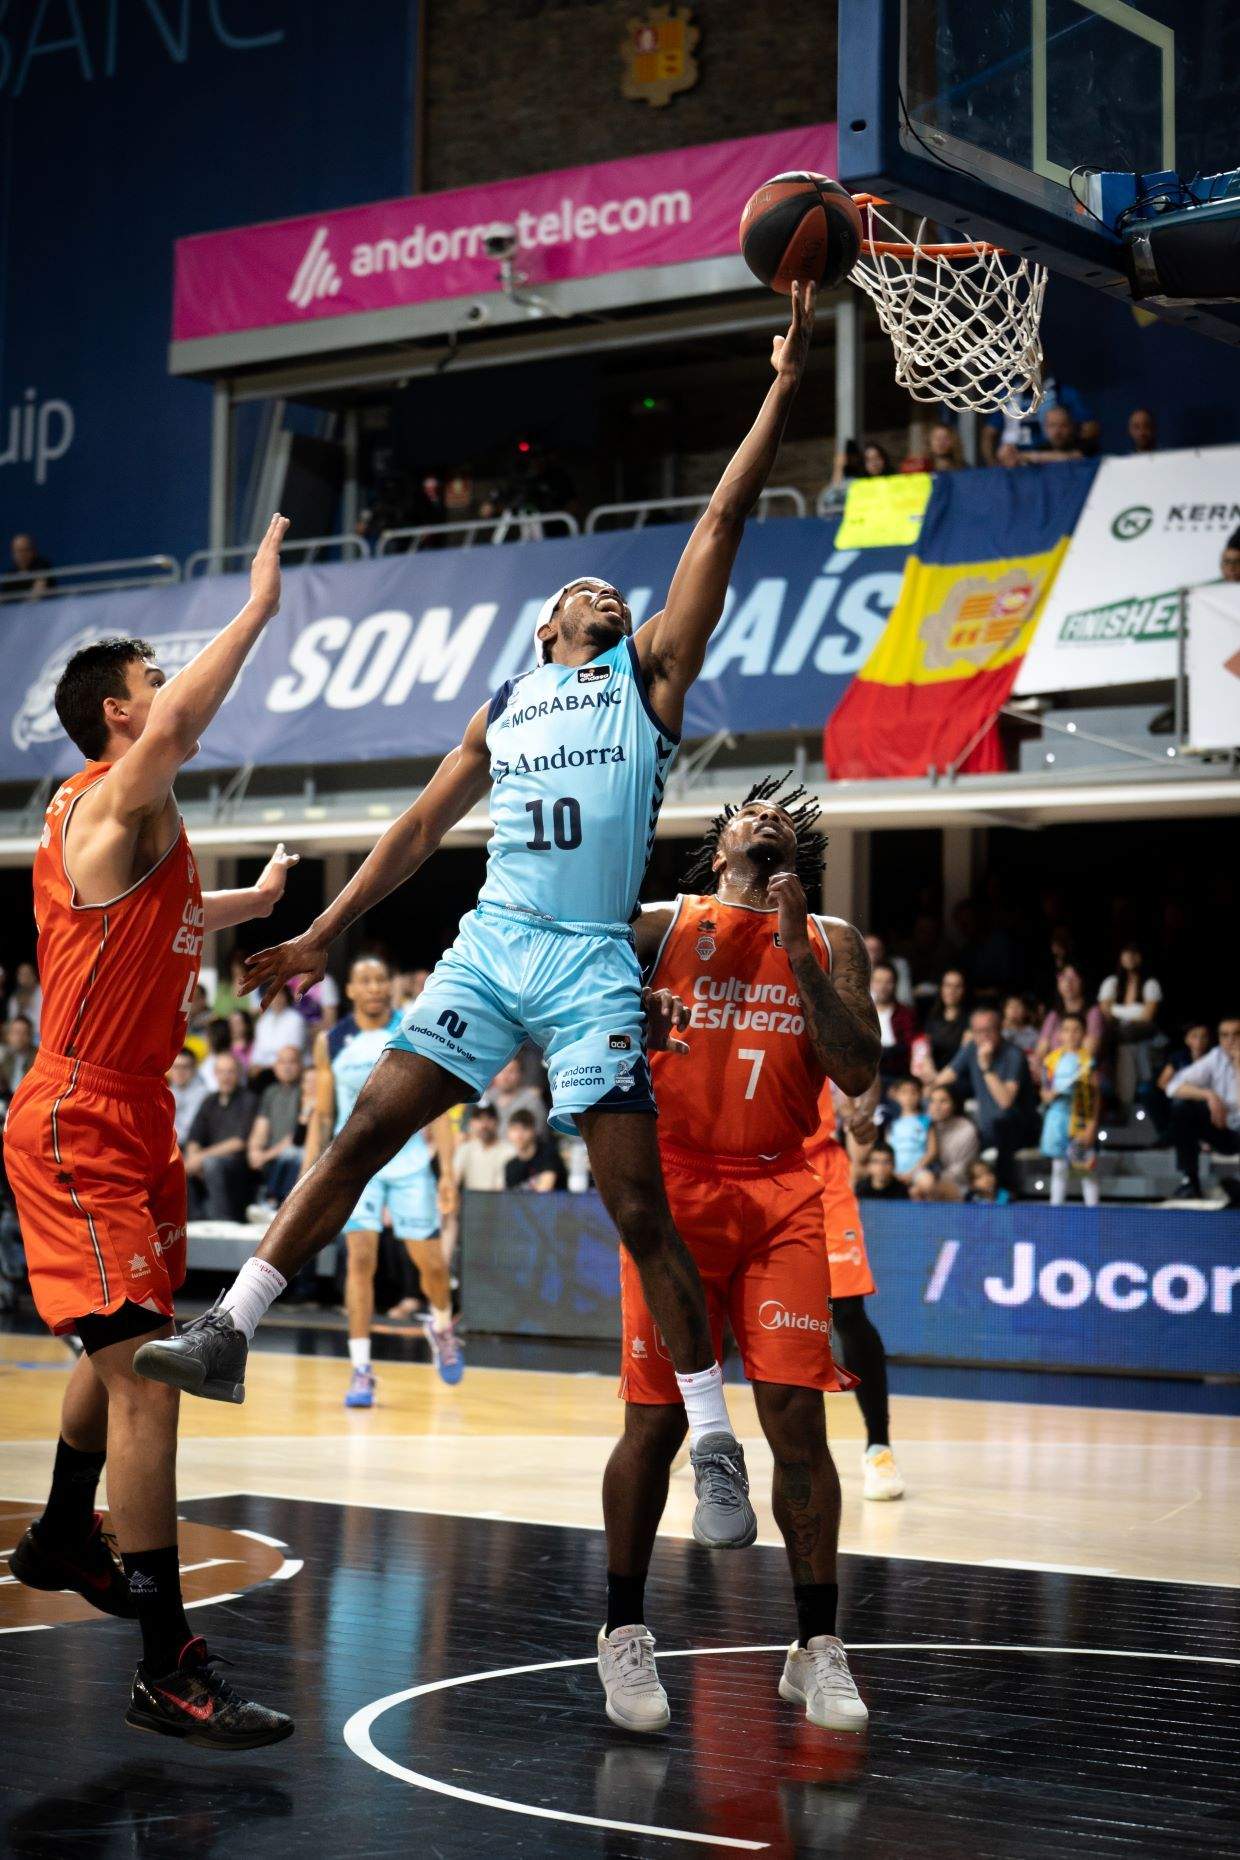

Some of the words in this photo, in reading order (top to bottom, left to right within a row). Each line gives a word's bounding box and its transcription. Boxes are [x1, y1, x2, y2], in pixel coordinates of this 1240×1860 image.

[350, 222, 508, 277] andorr
[516, 190, 691, 249] telecom
[266, 603, 498, 713] SOM
[699, 550, 905, 682] AÍS
[511, 687, 622, 728] MORABANC
[515, 744, 626, 776] Andorra
[525, 796, 583, 851] 10
[693, 975, 787, 1005] Cultura
[689, 1002, 805, 1036] Esfuerzo
[408, 1024, 446, 1043] Andorra
[446, 1039, 456, 1050] la
[610, 1040, 627, 1049] acb
[561, 1077, 606, 1089] telecom
[562, 1065, 602, 1078] andorra
[738, 1048, 766, 1100] 7
[769, 1310, 829, 1333] Midea
